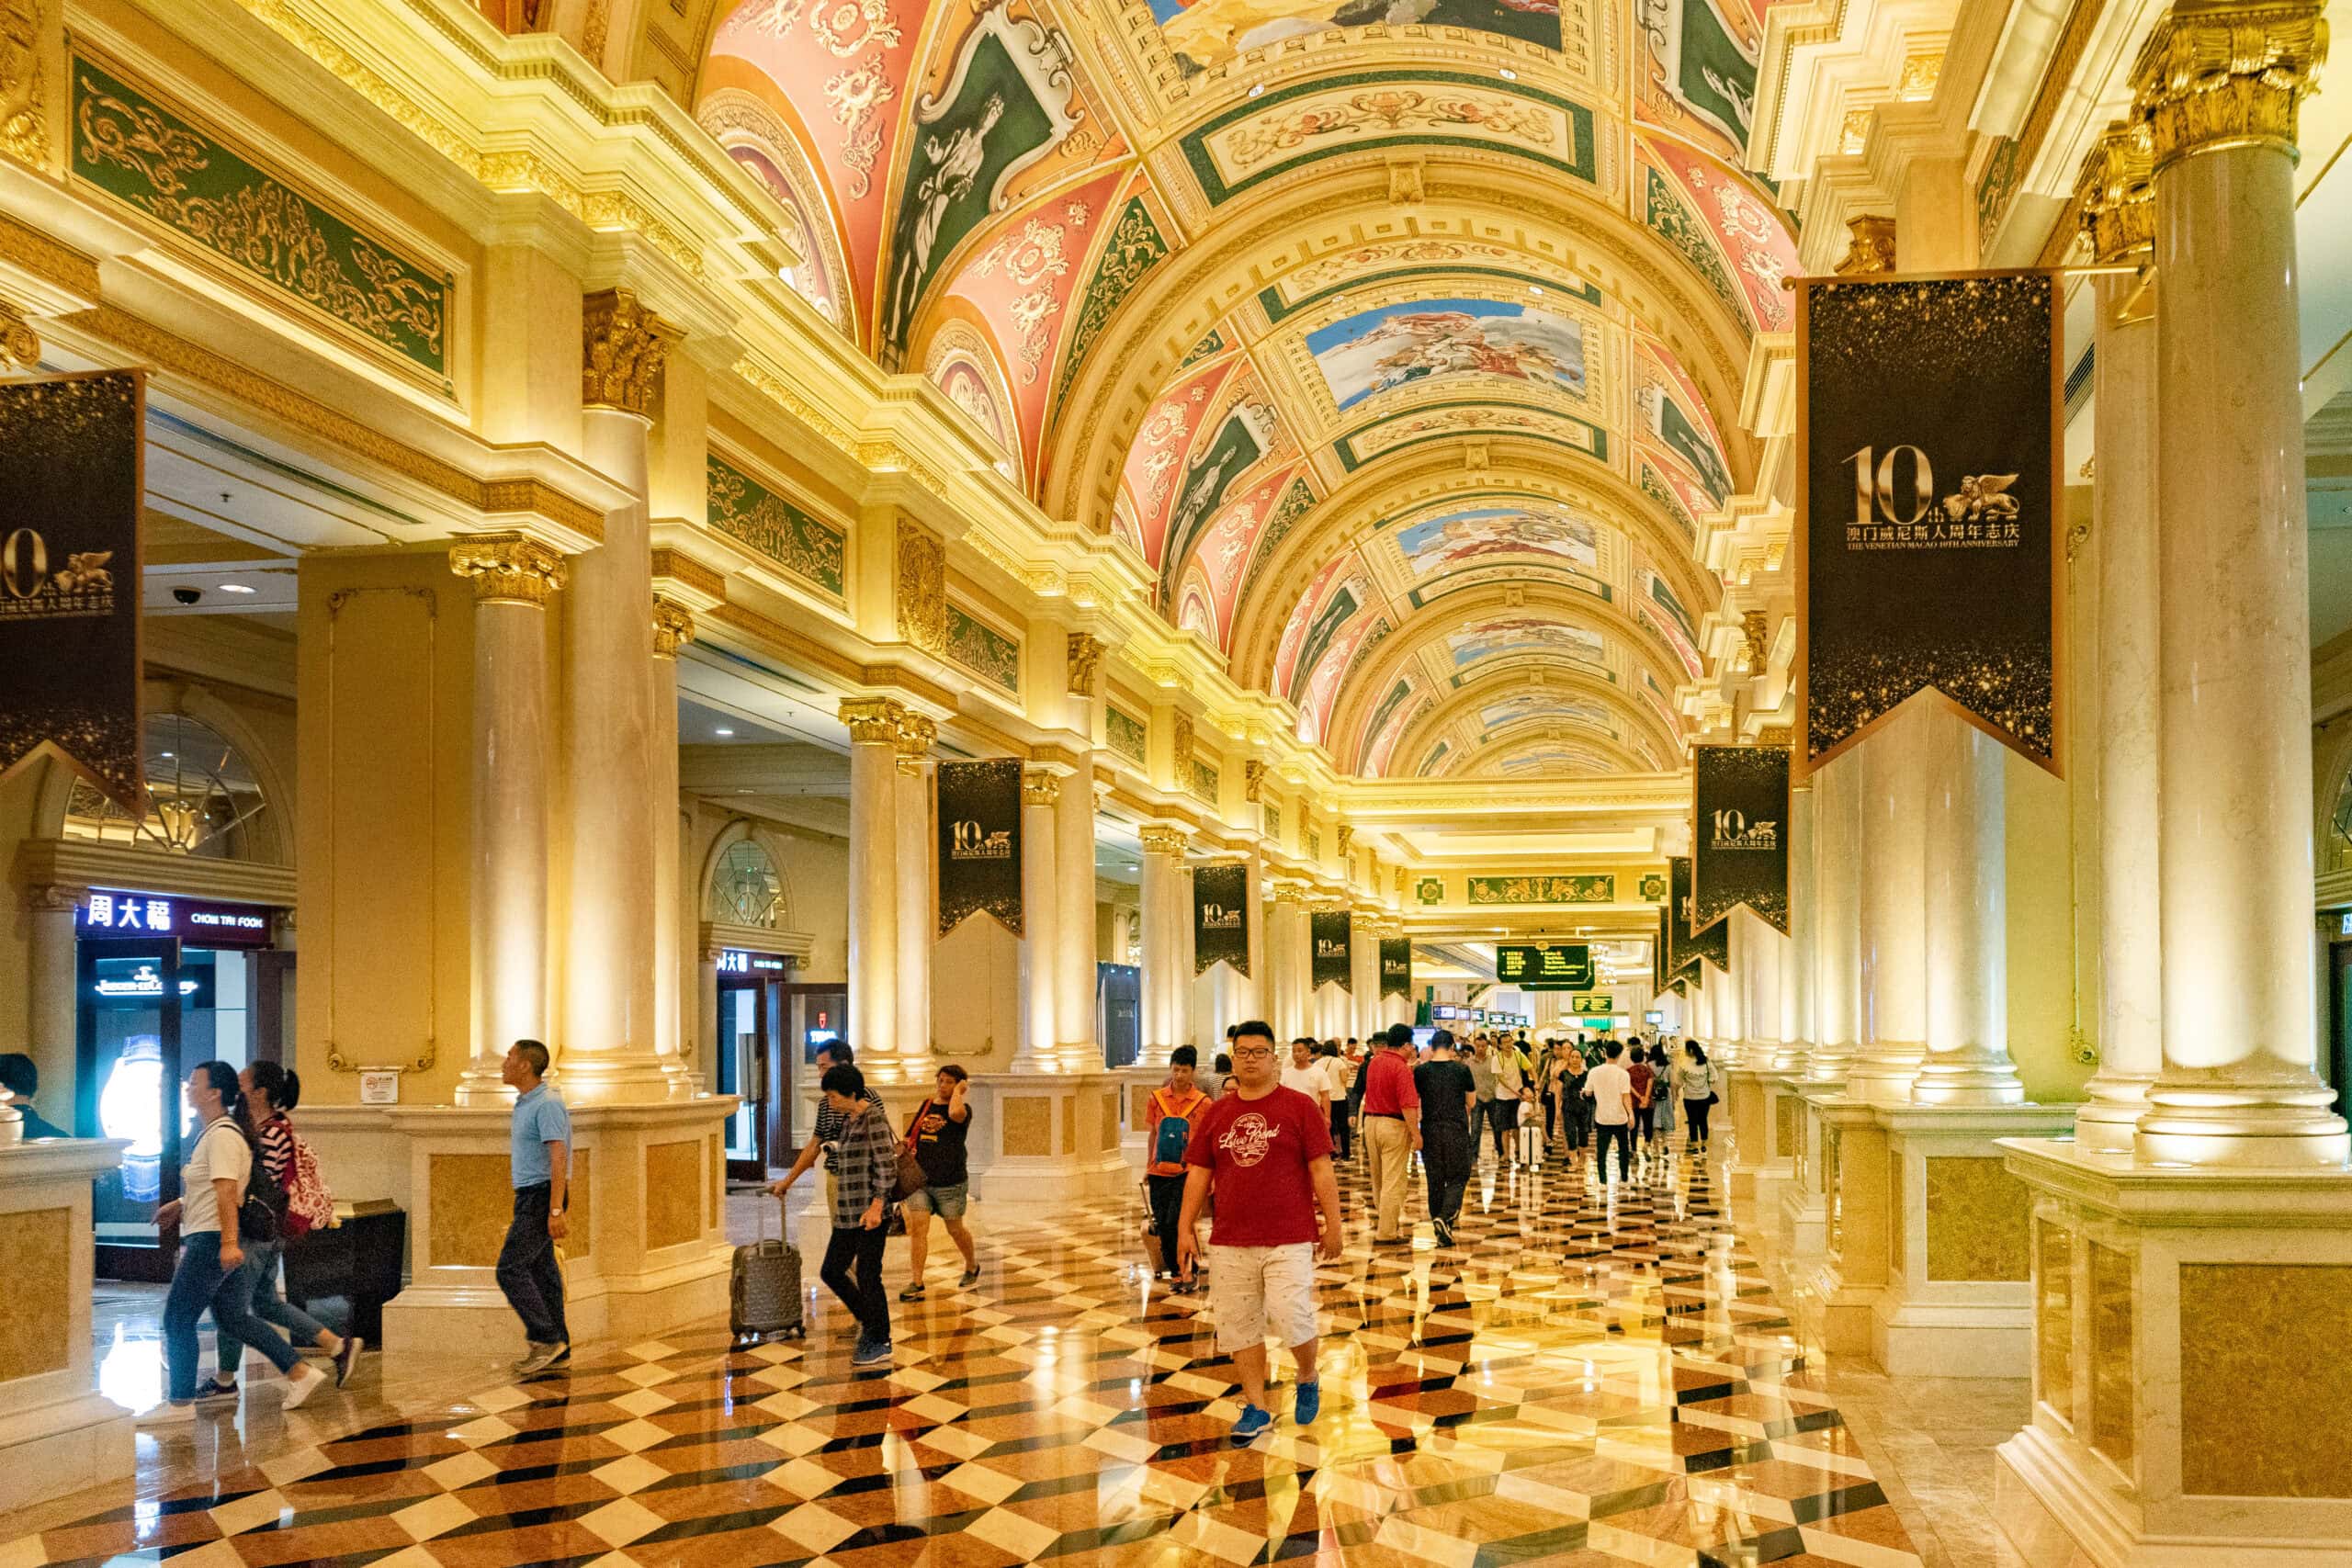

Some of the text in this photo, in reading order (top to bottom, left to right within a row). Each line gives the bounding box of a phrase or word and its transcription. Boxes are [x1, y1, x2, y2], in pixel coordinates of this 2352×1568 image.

[87, 895, 171, 931] 周大福
[191, 912, 264, 928] CHOW TAI FOOK
